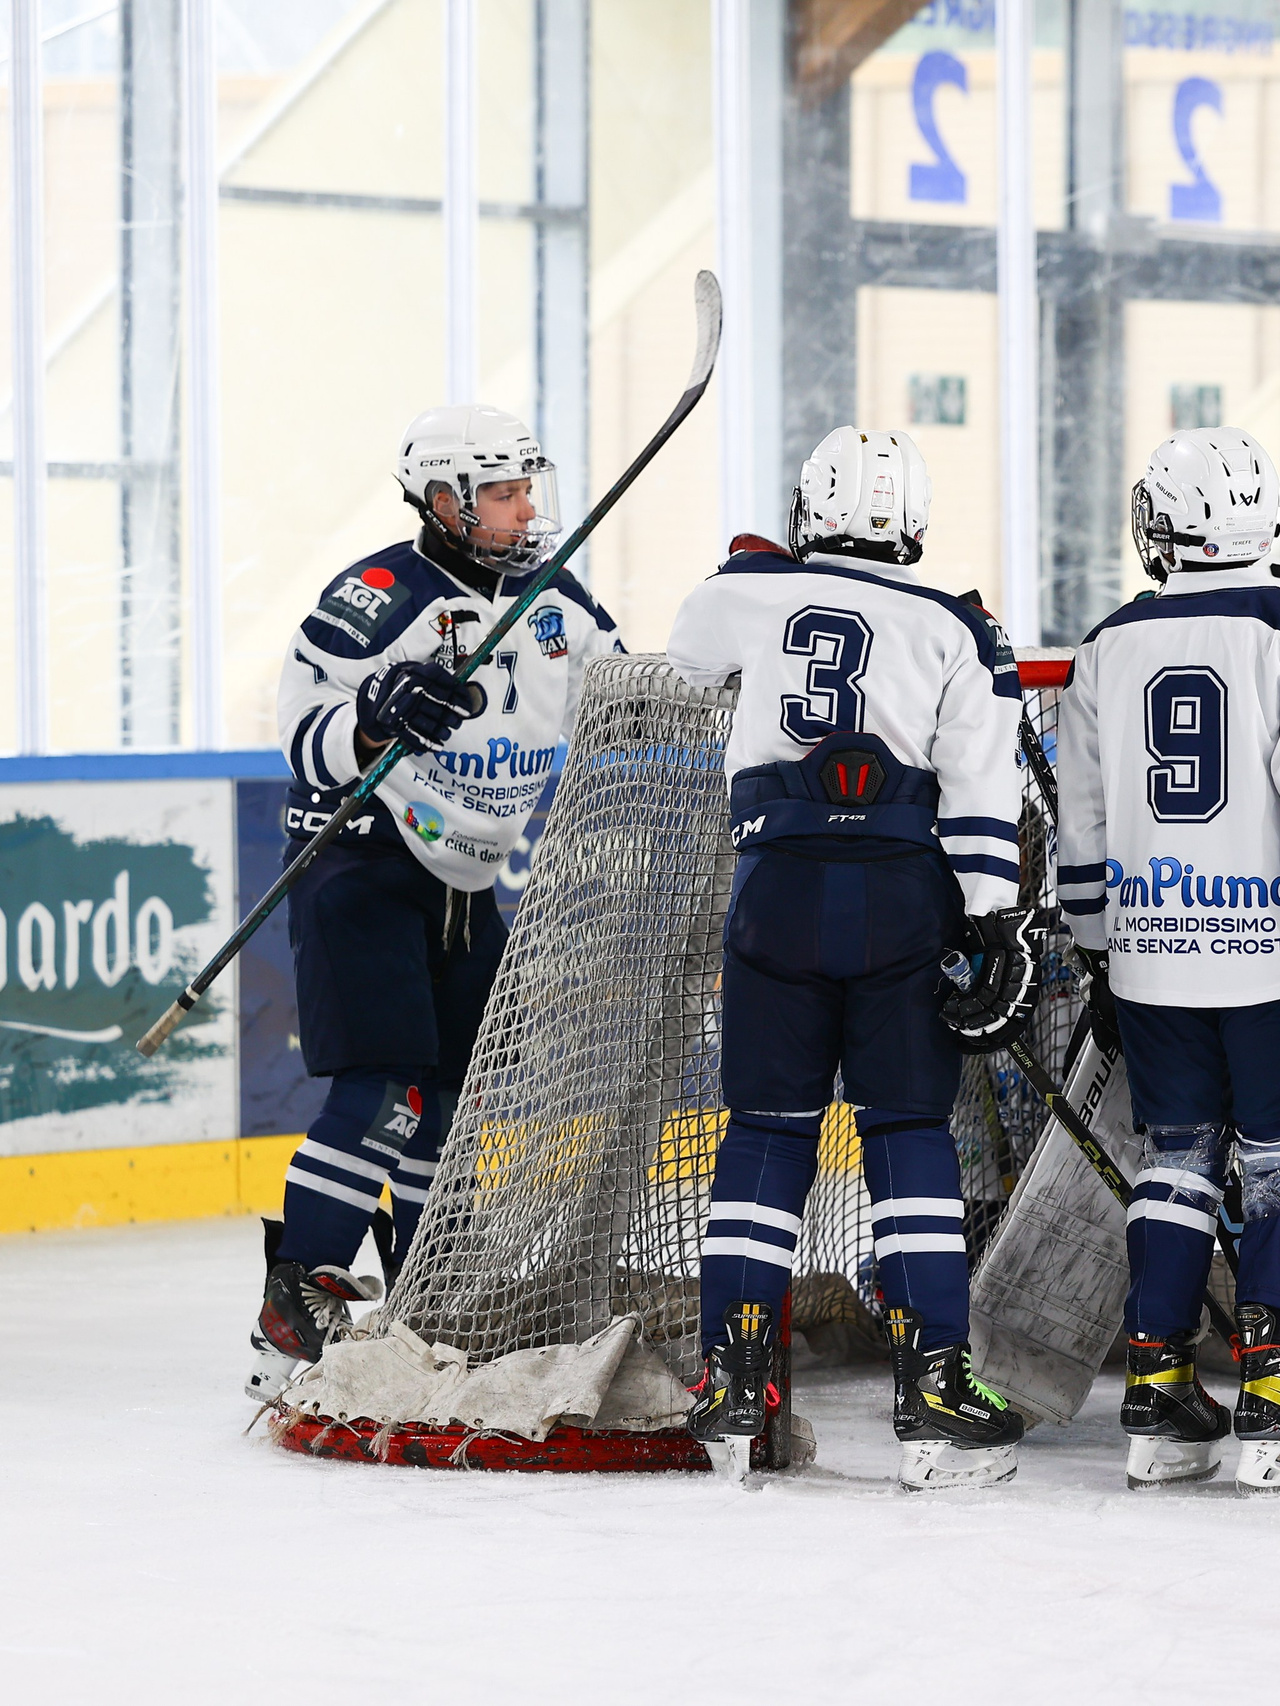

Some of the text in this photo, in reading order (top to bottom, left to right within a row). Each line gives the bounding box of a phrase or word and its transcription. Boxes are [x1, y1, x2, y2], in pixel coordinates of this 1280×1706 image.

[519, 446, 539, 456] CCM
[419, 458, 452, 468] CCM
[426, 510, 447, 534] CCM
[459, 511, 479, 526] CCM
[332, 583, 380, 620] AGL
[497, 650, 519, 714] 7
[779, 604, 875, 747] 3
[1143, 664, 1229, 824] 9
[430, 736, 557, 780] anPium
[427, 768, 444, 784] IL
[444, 837, 476, 859] Città
[1125, 917, 1277, 933] MORBIDISSIMO
[1106, 937, 1132, 953] ANE
[1136, 938, 1202, 955] SENZA
